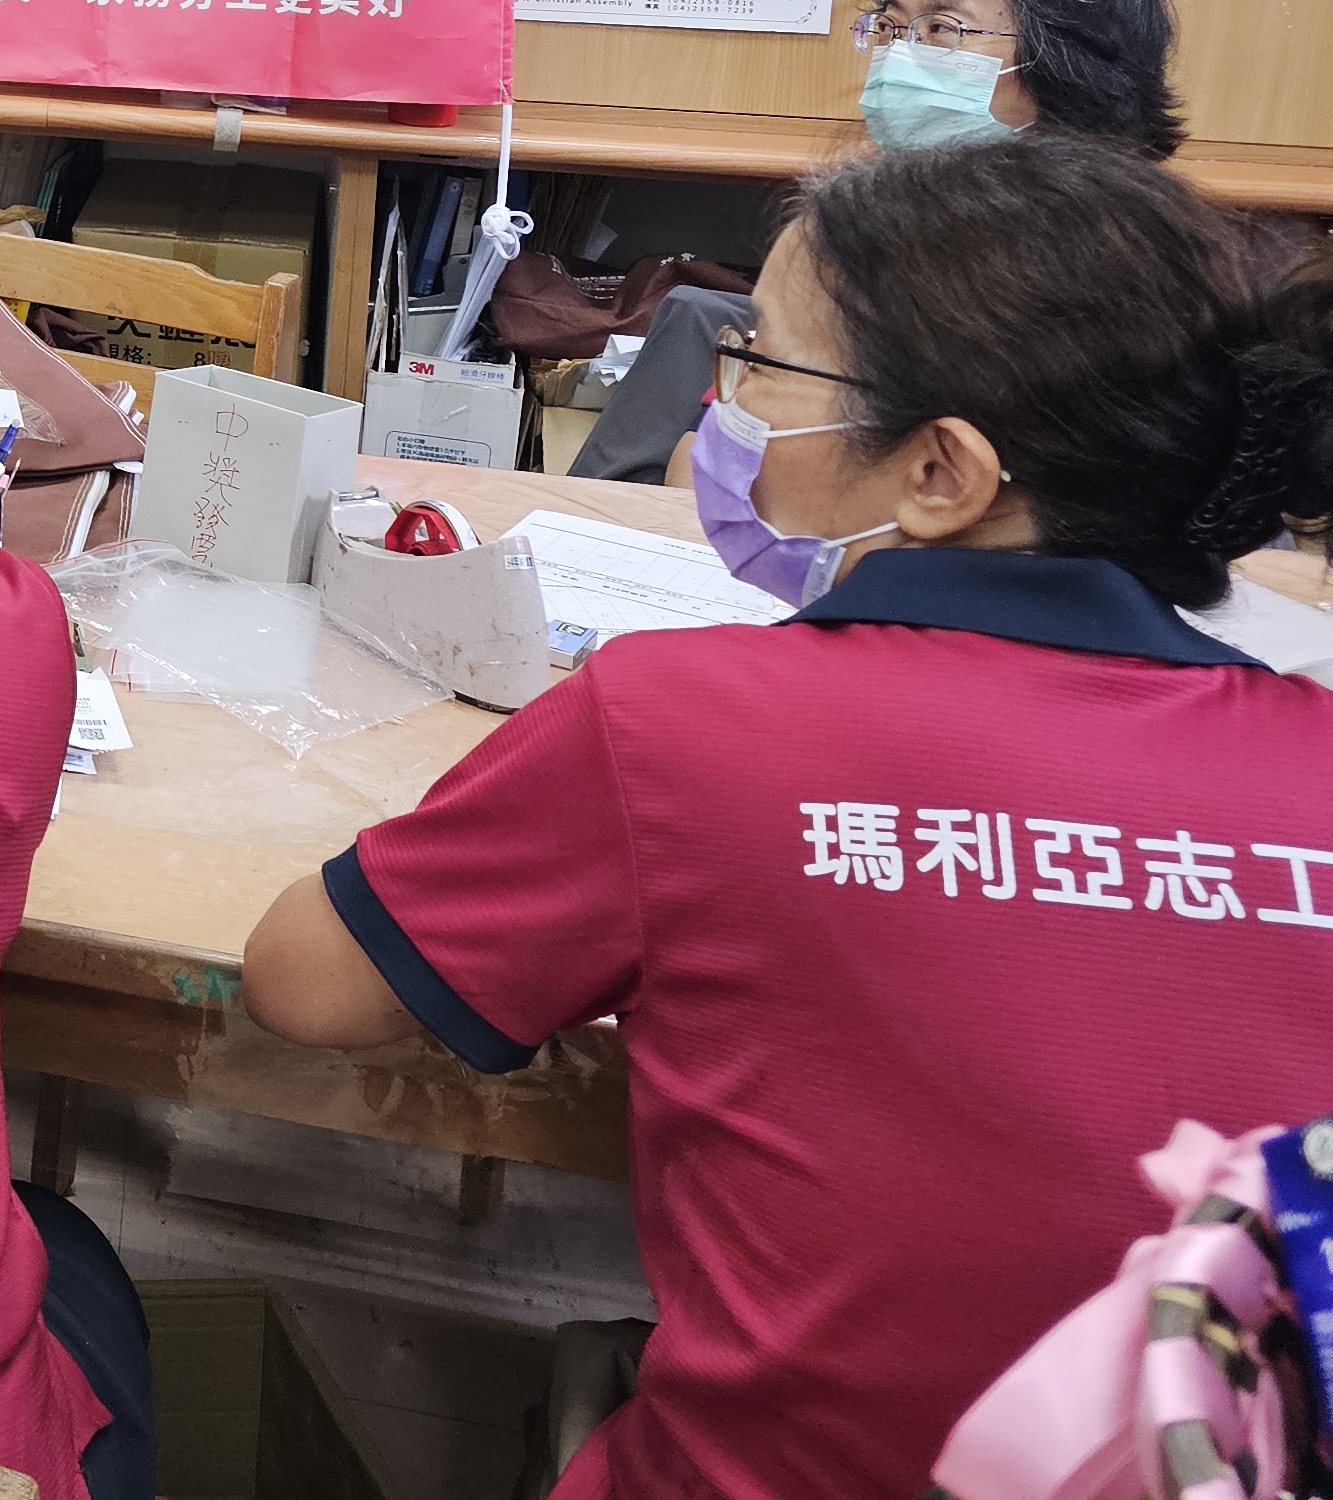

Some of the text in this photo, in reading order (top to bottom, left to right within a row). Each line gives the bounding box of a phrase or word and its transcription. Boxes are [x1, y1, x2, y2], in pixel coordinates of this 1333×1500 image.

[409, 361, 435, 376] 3M
[800, 801, 1333, 929] 瑪利亞志工
